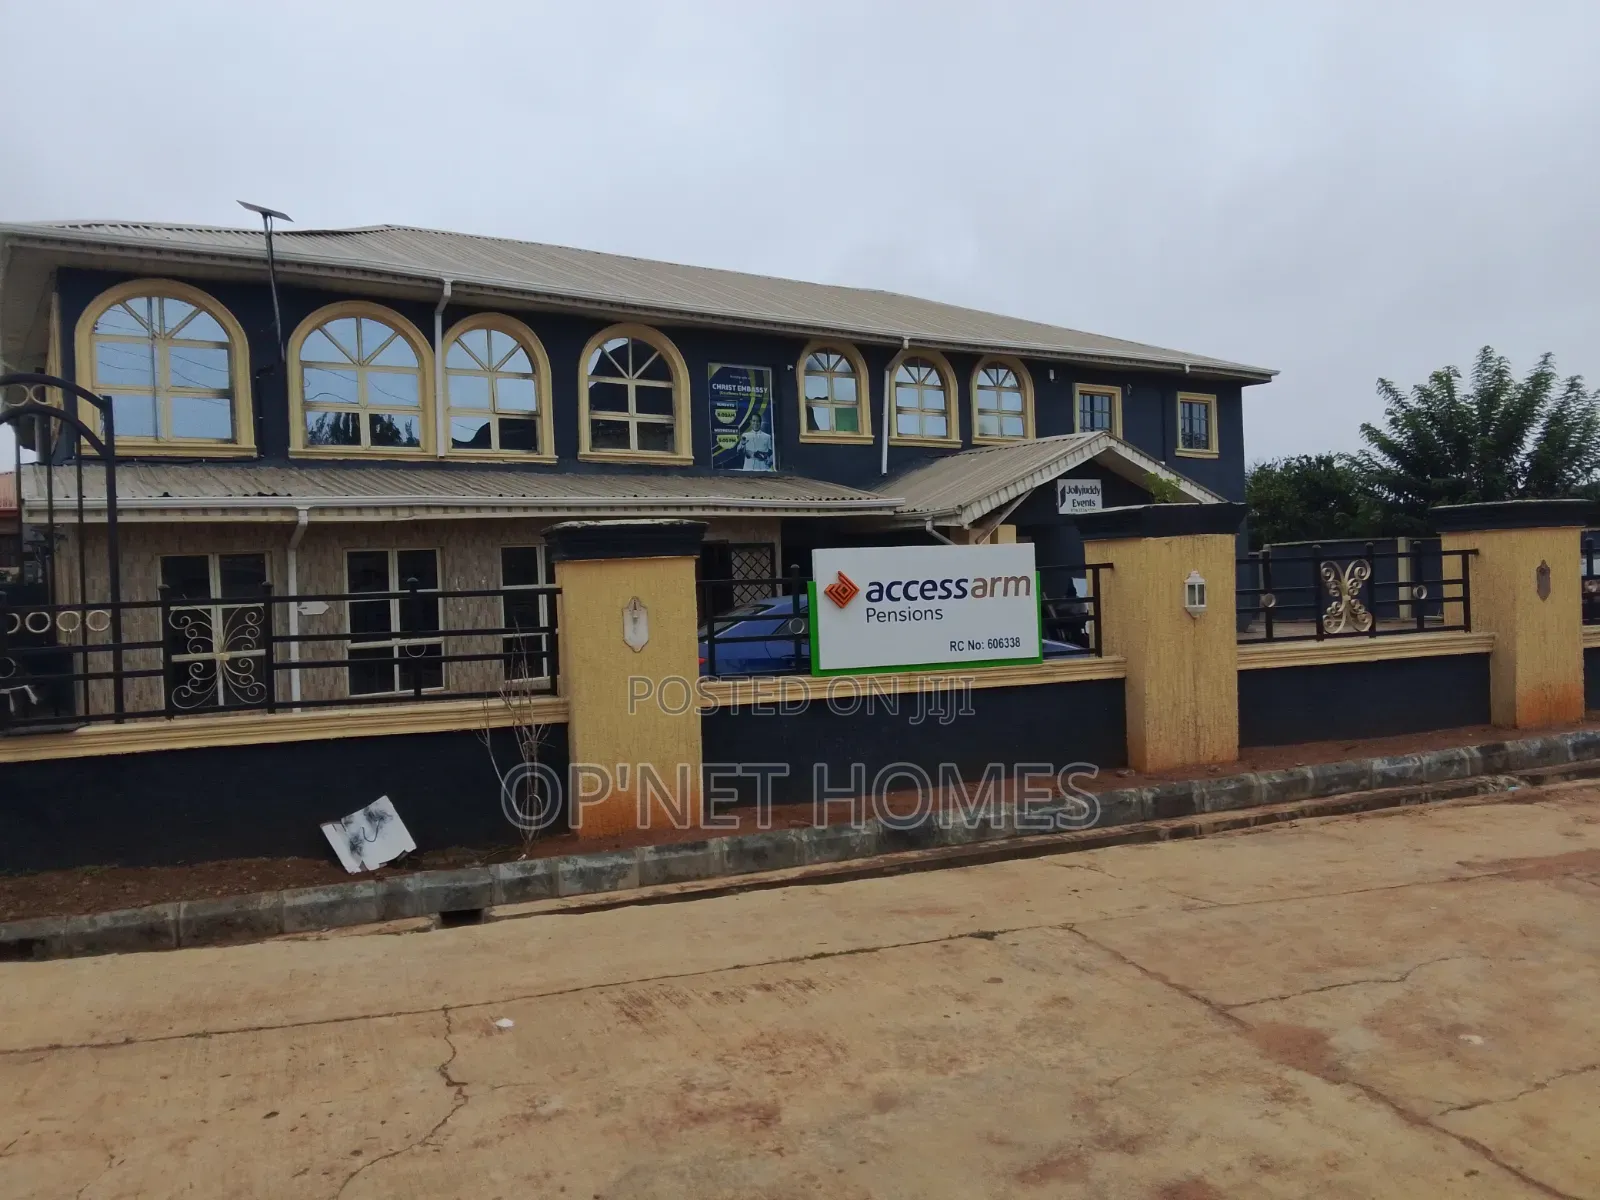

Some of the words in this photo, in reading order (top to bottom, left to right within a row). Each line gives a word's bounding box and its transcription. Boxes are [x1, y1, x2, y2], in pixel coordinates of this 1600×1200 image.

[712, 383, 736, 391] CHRIST
[737, 385, 768, 393] EMBASSY
[1067, 485, 1100, 496] Jollyjuddy
[1072, 499, 1096, 507] Events
[866, 607, 943, 623] Pensions
[950, 640, 964, 652] RC
[968, 639, 985, 651] No:
[987, 637, 1021, 650] 606338
